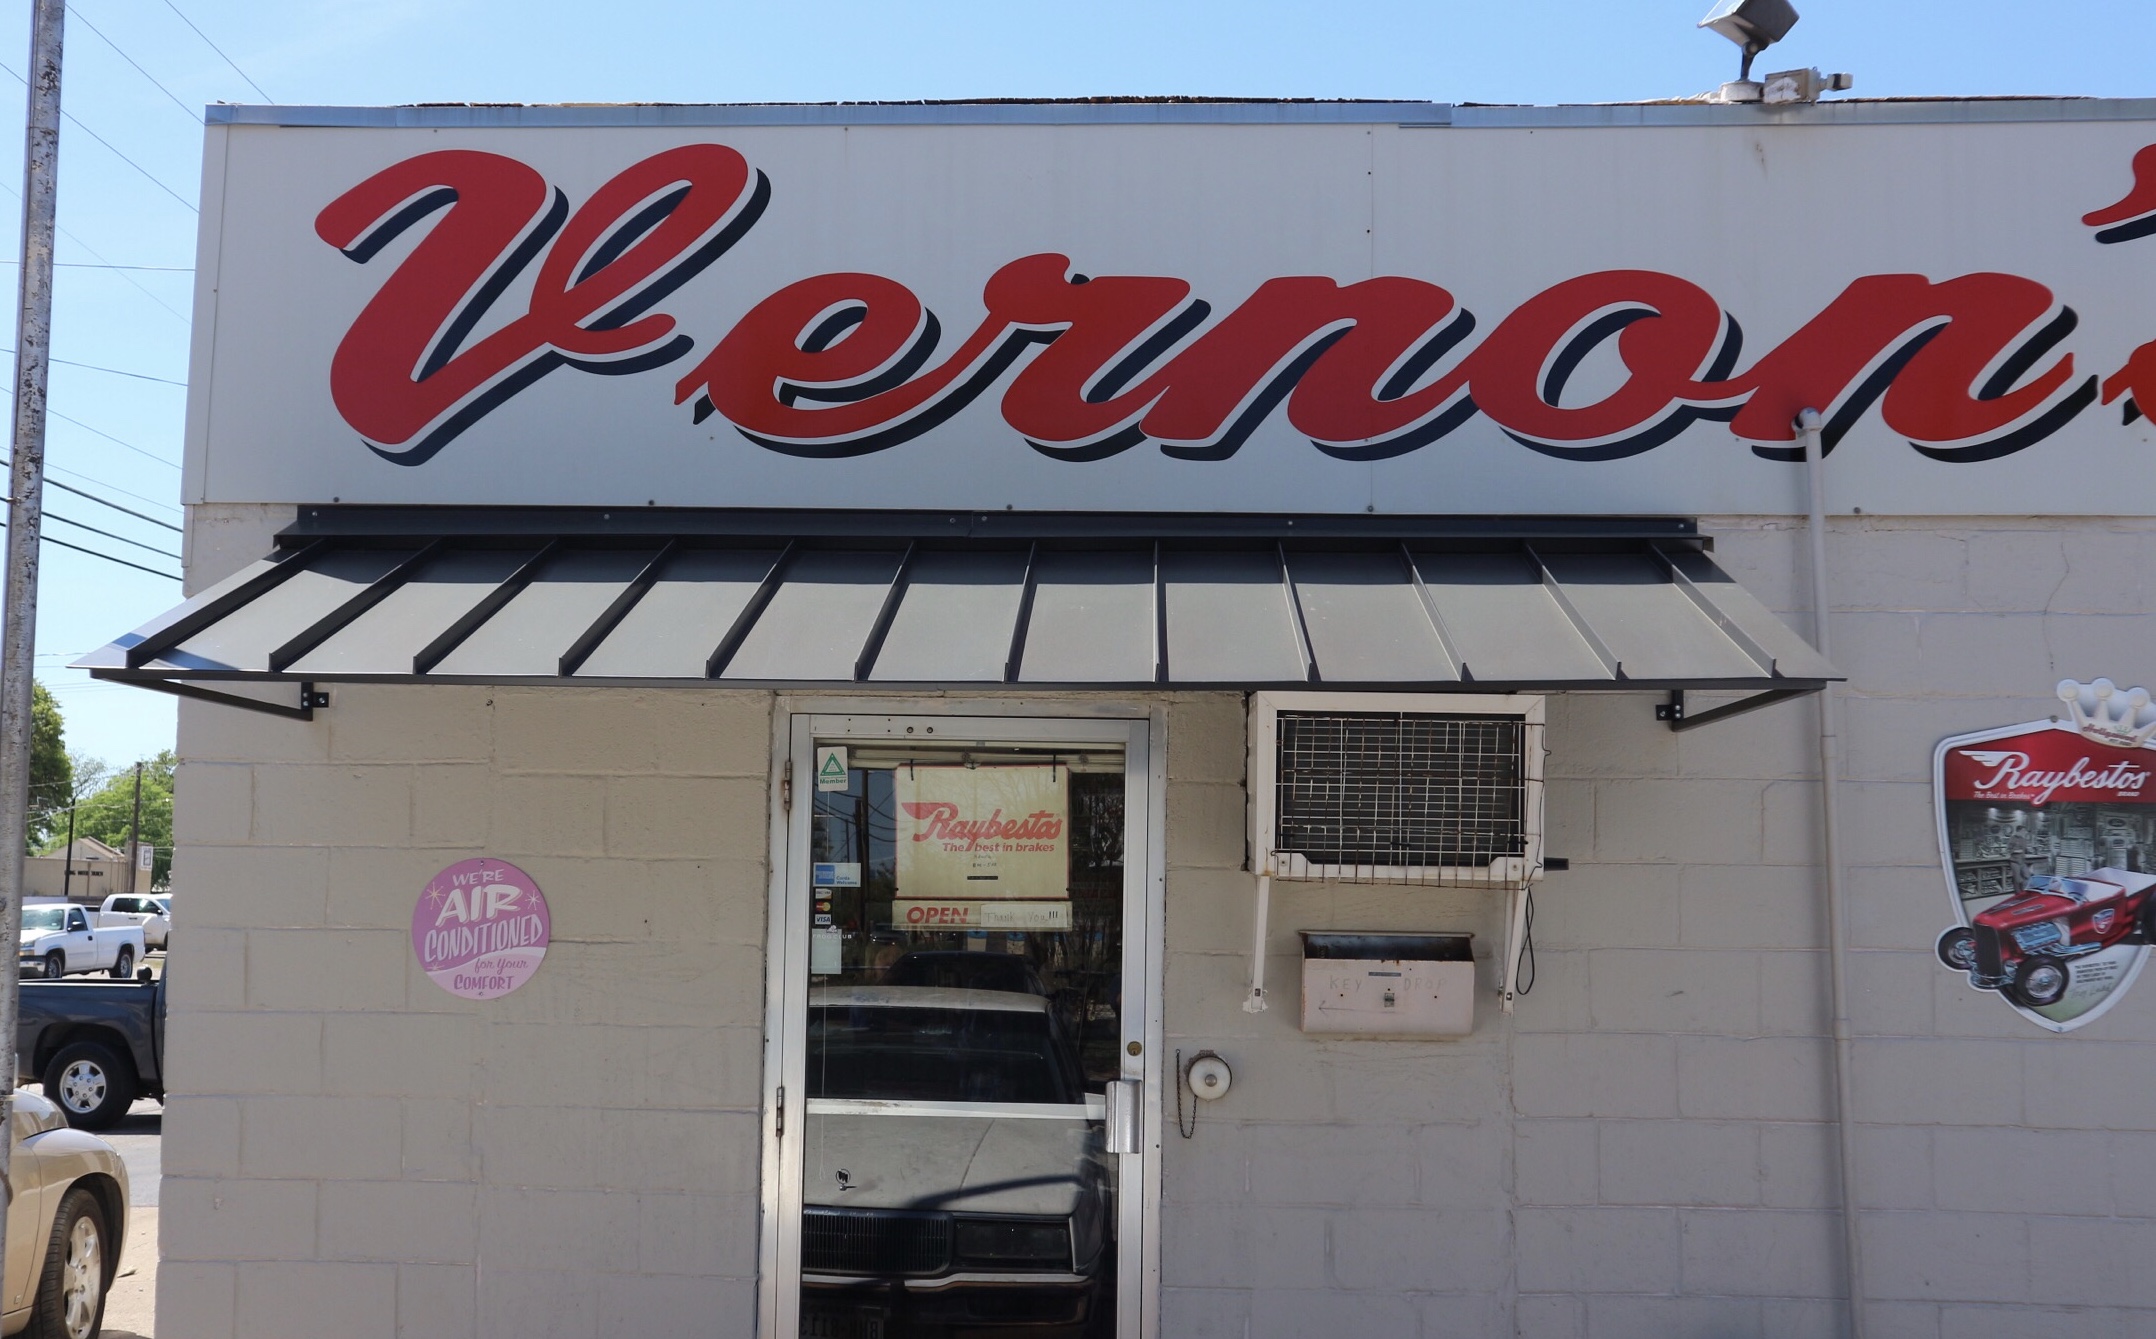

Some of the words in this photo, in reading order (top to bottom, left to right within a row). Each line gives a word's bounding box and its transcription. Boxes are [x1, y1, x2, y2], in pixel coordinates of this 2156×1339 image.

[314, 143, 2156, 466] Vernon'
[1958, 750, 2146, 805] Raybestos
[901, 802, 1063, 851] Raybestos
[942, 842, 965, 852] The
[974, 842, 1000, 852] best
[1003, 842, 1013, 852] in
[1016, 842, 1055, 852] brakes
[452, 868, 505, 886] WE'RE
[435, 884, 523, 927] AIR
[906, 906, 969, 924] OPEN
[424, 914, 543, 963] CONDITIONED
[475, 958, 495, 974] for
[453, 974, 515, 990] COMFORT
[1329, 975, 1363, 993] KEY
[1404, 977, 1447, 991] DROP
